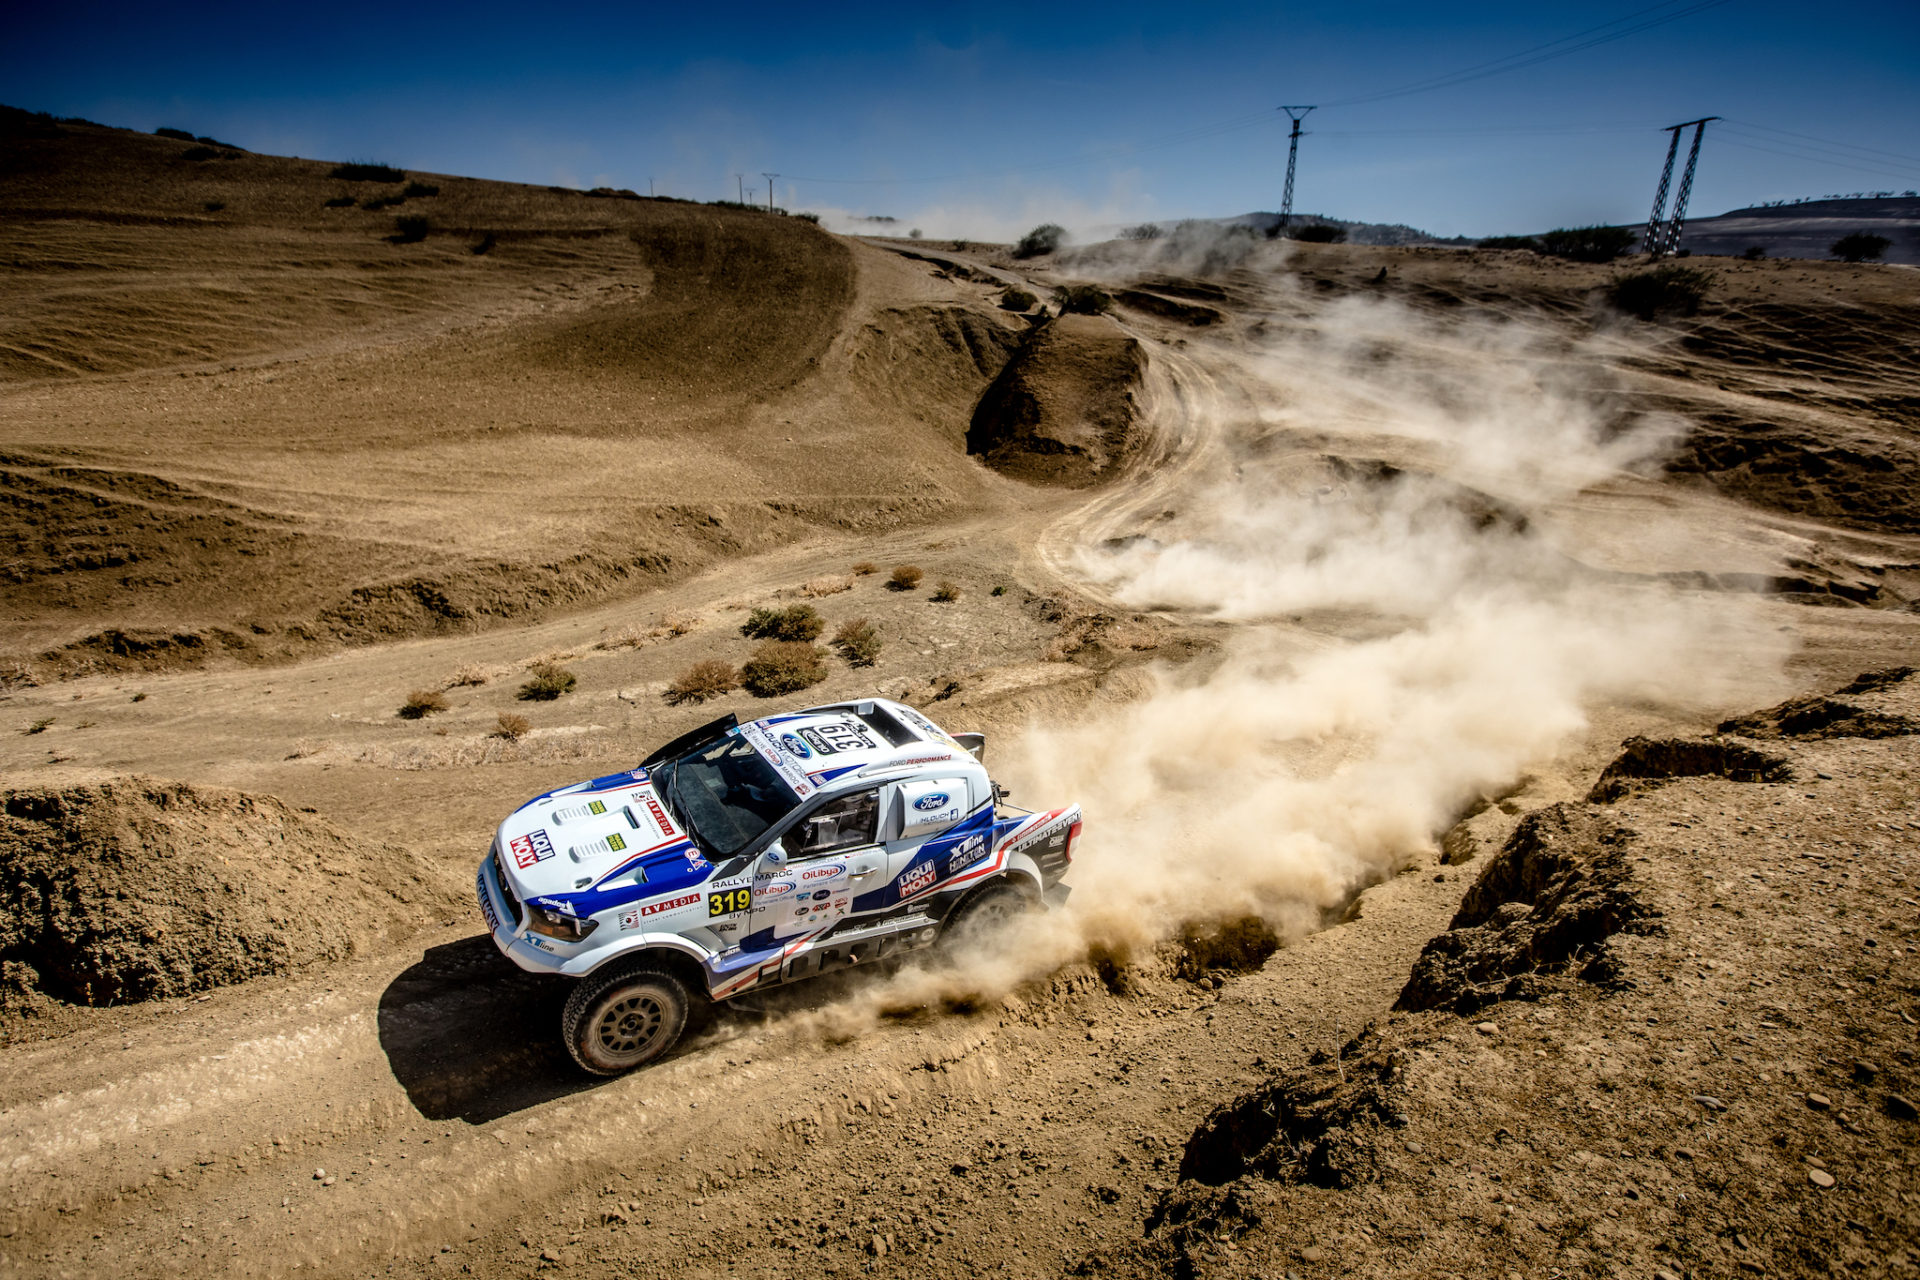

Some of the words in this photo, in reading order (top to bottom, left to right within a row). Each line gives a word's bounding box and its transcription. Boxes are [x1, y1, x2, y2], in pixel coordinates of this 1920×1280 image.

[819, 726, 864, 750] 319
[889, 759, 907, 767] FORD
[905, 754, 952, 765] PERFORMANCE
[920, 794, 944, 810] Ford
[648, 800, 673, 835] AVMEDIA
[511, 836, 538, 868] MOLY
[528, 829, 555, 861] LIQUI
[712, 876, 753, 889] RALLYE
[755, 869, 793, 882] MAROC
[802, 867, 839, 880] OiLibya
[901, 861, 933, 886] LIQUI
[754, 884, 789, 897] OiLibya
[902, 872, 935, 896] MOLY
[538, 897, 567, 909] agados
[644, 894, 700, 915] AVMEDIA
[709, 889, 751, 915] 319
[729, 912, 742, 920] By
[743, 906, 766, 916] NPO
[524, 932, 555, 952] XTline
